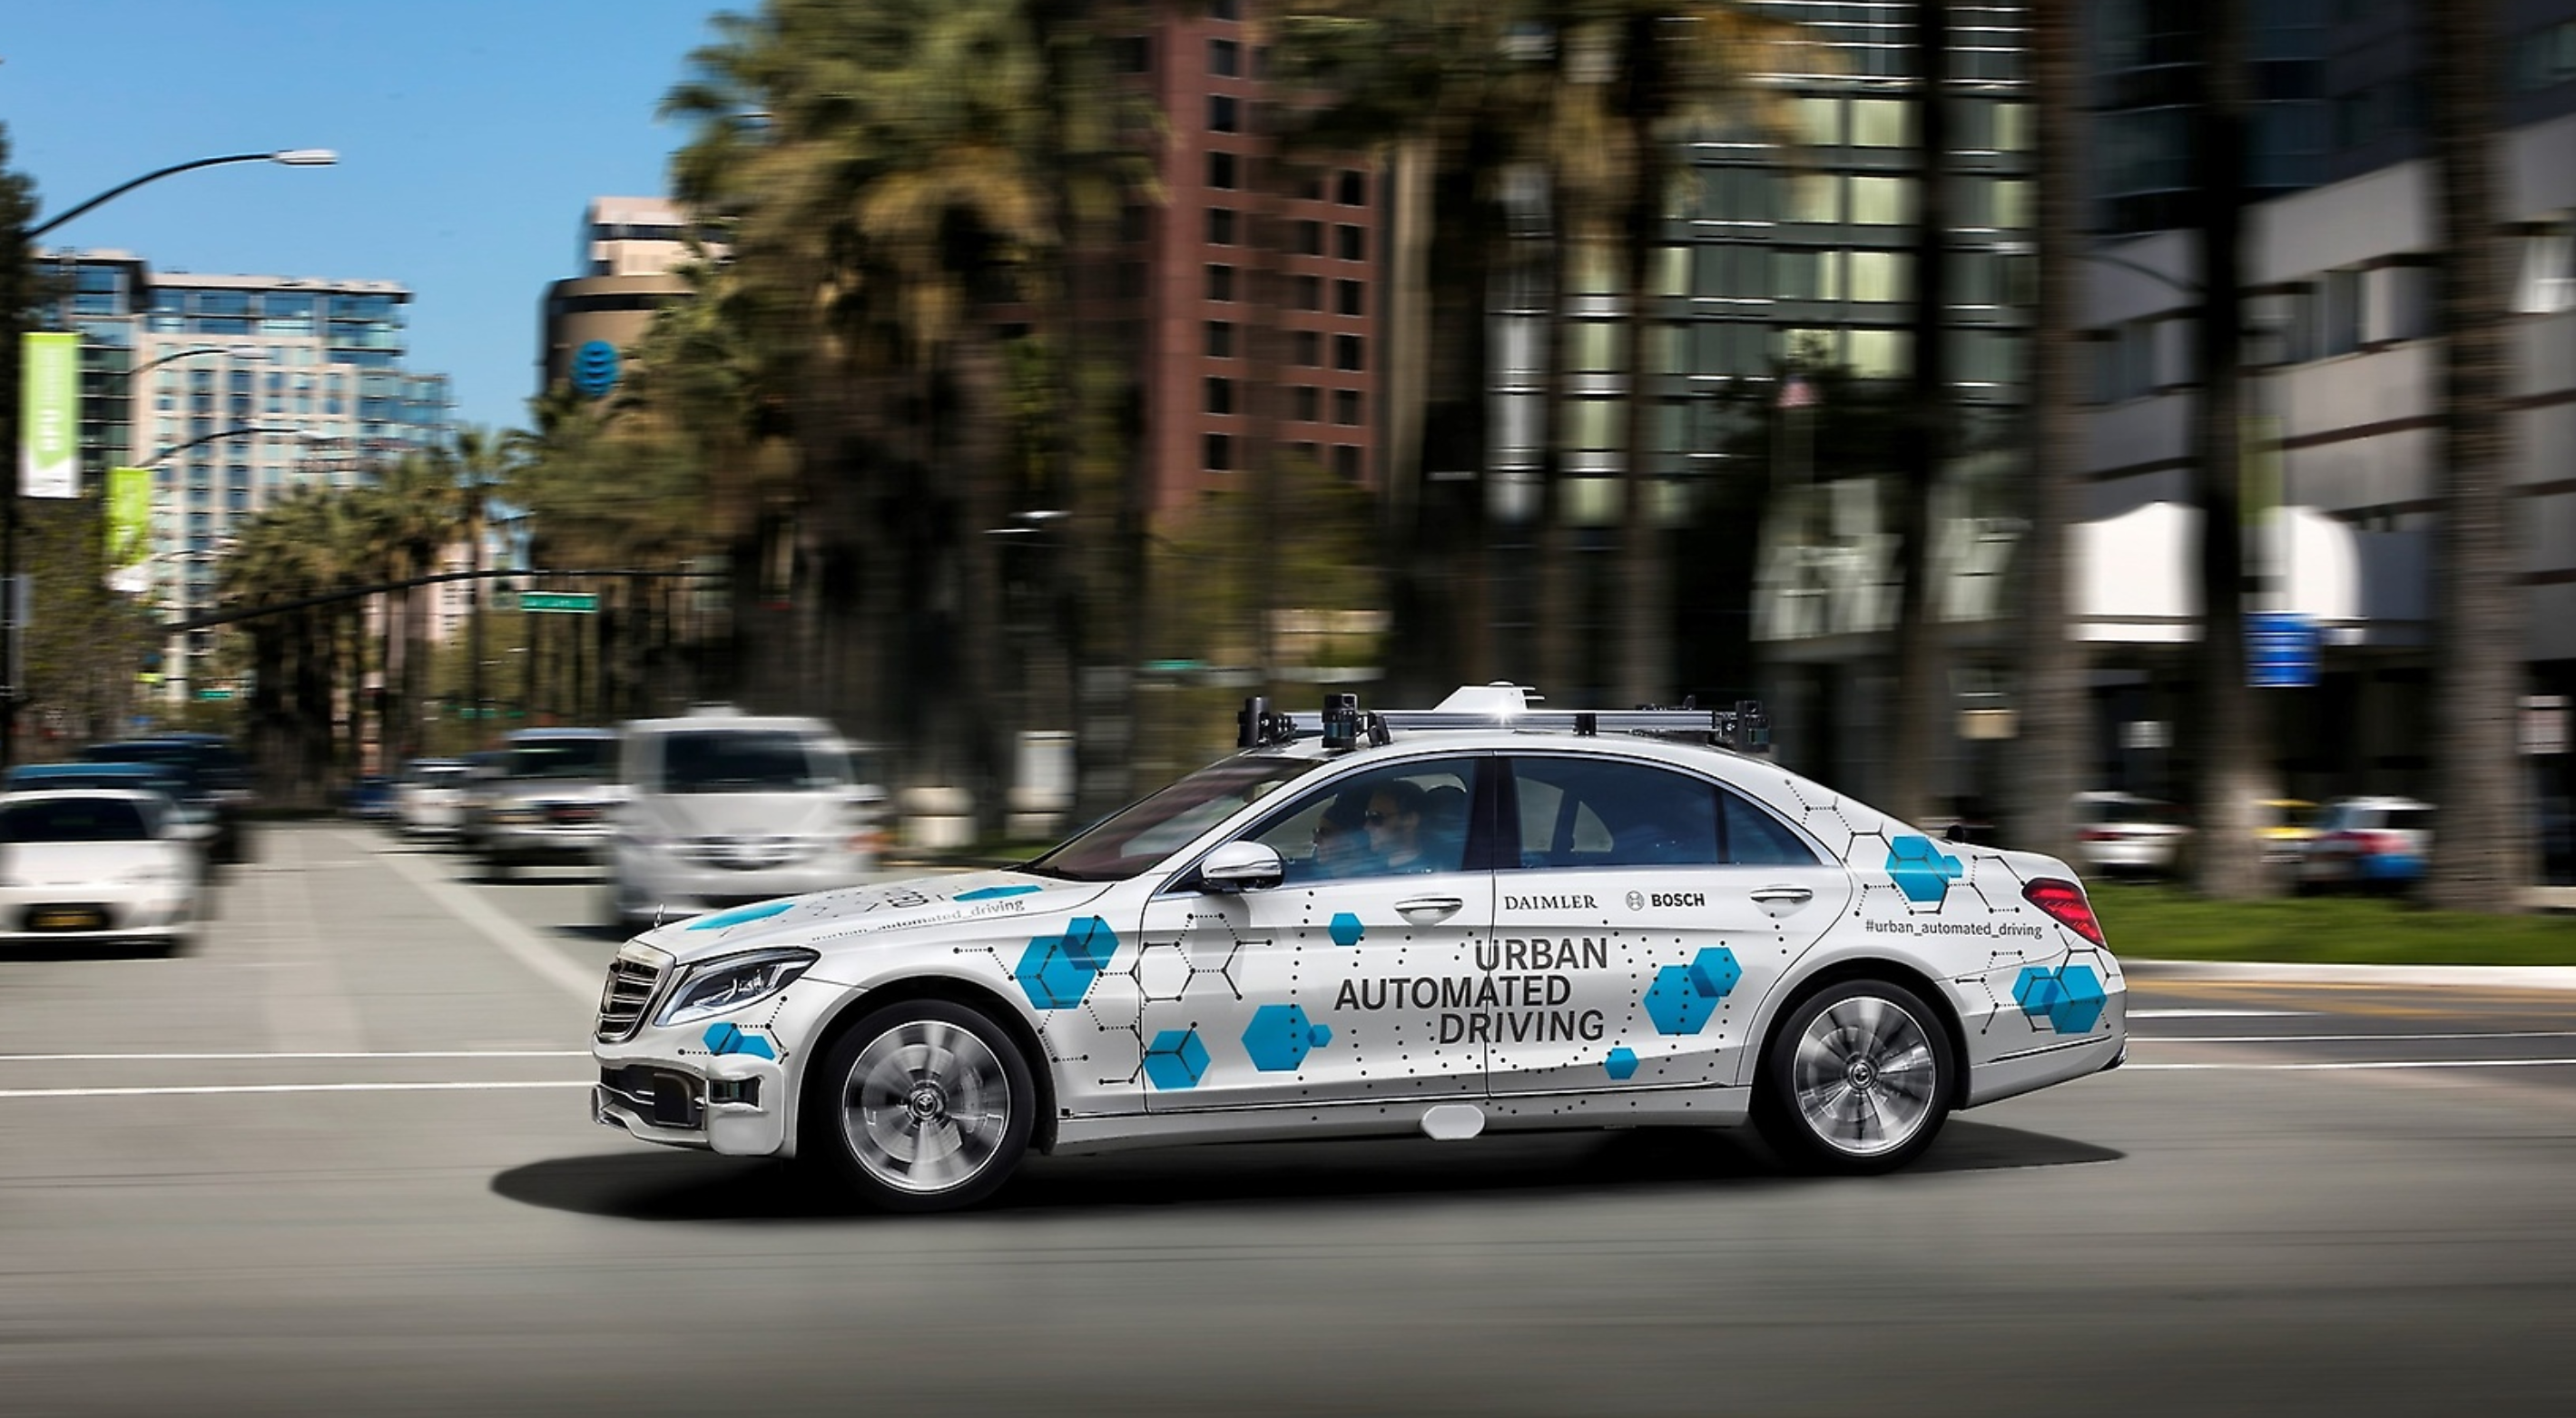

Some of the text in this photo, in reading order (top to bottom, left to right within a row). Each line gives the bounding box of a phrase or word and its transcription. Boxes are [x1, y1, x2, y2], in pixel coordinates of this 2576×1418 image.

[1504, 894, 1598, 911] DAIMLER
[1651, 892, 1706, 907] BOSCH
[811, 900, 1025, 941] _automated_driving
[1865, 920, 2043, 940] #urban_automated_driving
[1474, 937, 1608, 971] URBAN
[1333, 975, 1571, 1010] AUTOMATED
[1439, 1009, 1605, 1044] DRIVING
